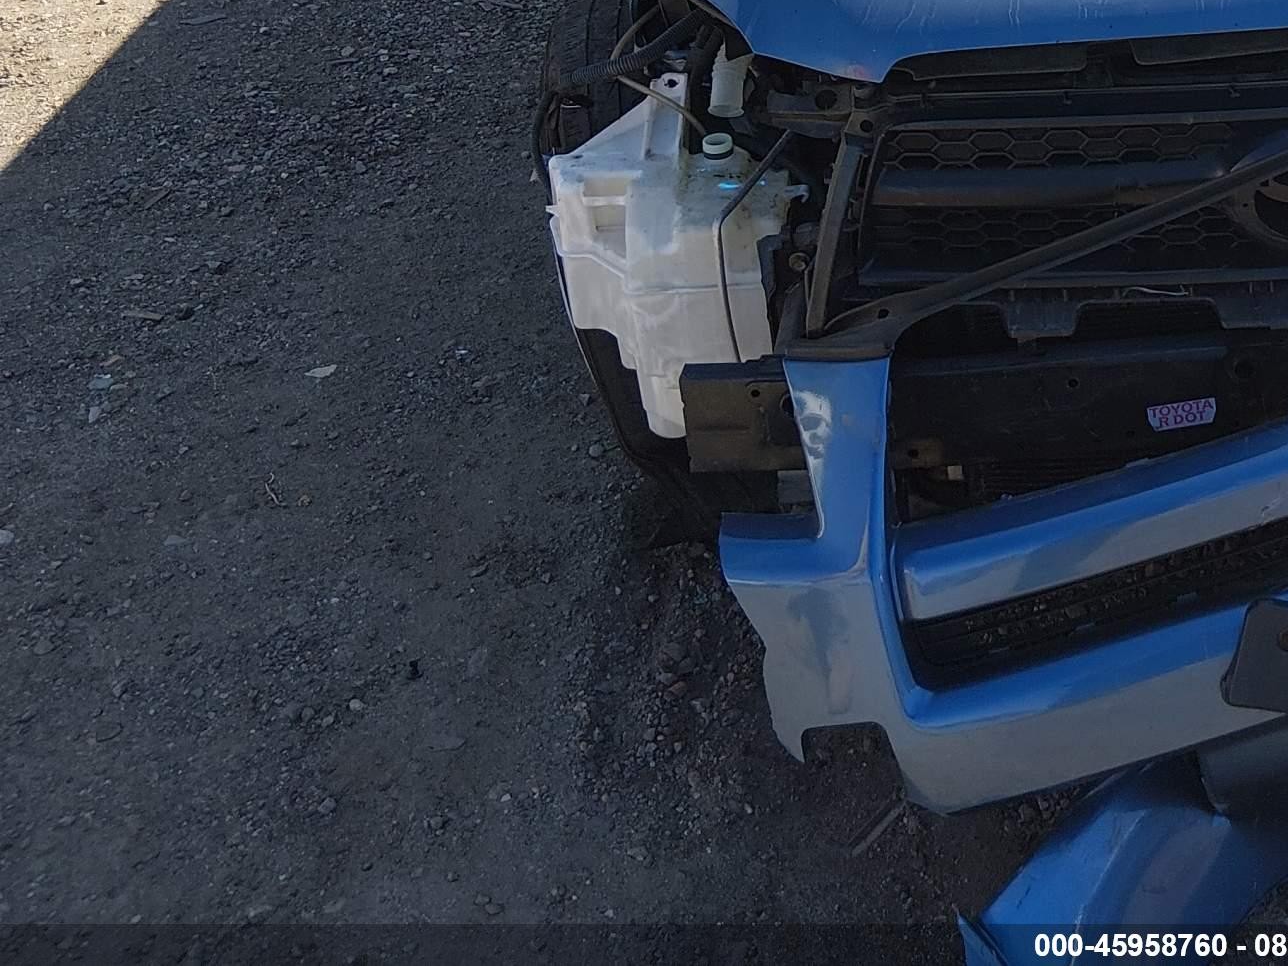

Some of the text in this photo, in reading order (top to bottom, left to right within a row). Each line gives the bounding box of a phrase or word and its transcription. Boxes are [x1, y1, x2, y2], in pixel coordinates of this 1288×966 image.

[1149, 399, 1214, 419] TOYOTA
[1158, 410, 1207, 428] R DOT
